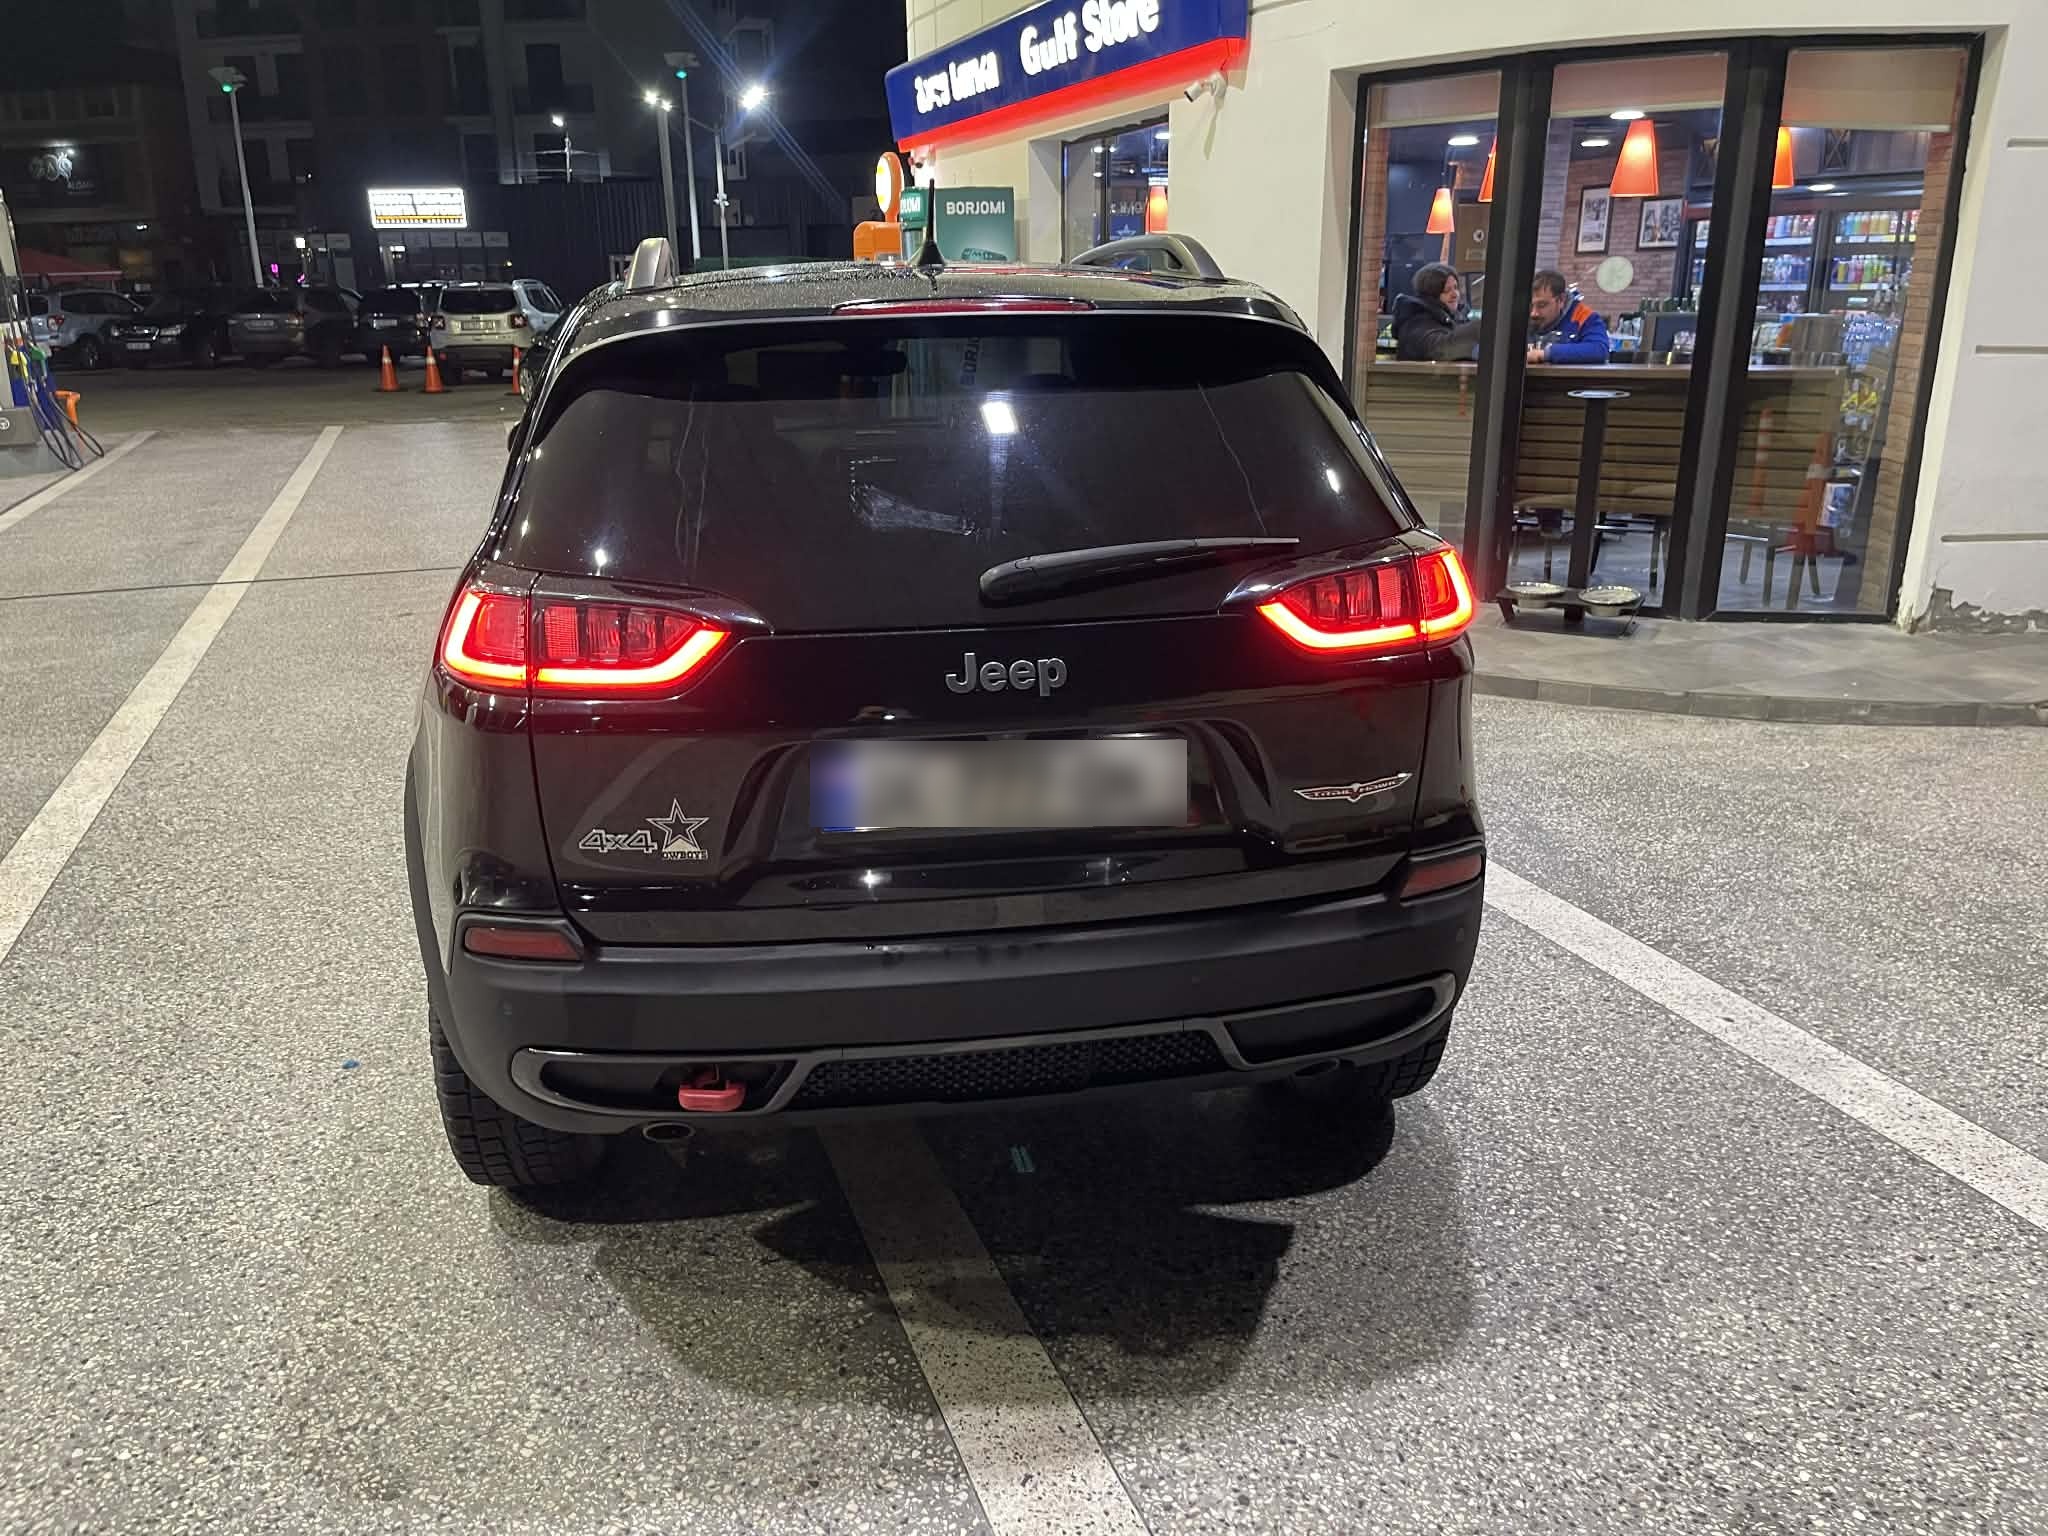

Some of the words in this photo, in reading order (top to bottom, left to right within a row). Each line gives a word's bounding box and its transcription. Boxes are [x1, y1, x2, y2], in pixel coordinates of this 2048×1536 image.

[1020, 12, 1079, 75] Gulf
[1082, 0, 1160, 52] Store
[946, 201, 1006, 215] BORJOMI
[945, 652, 1067, 697] Jeep
[578, 828, 658, 854] 4x4
